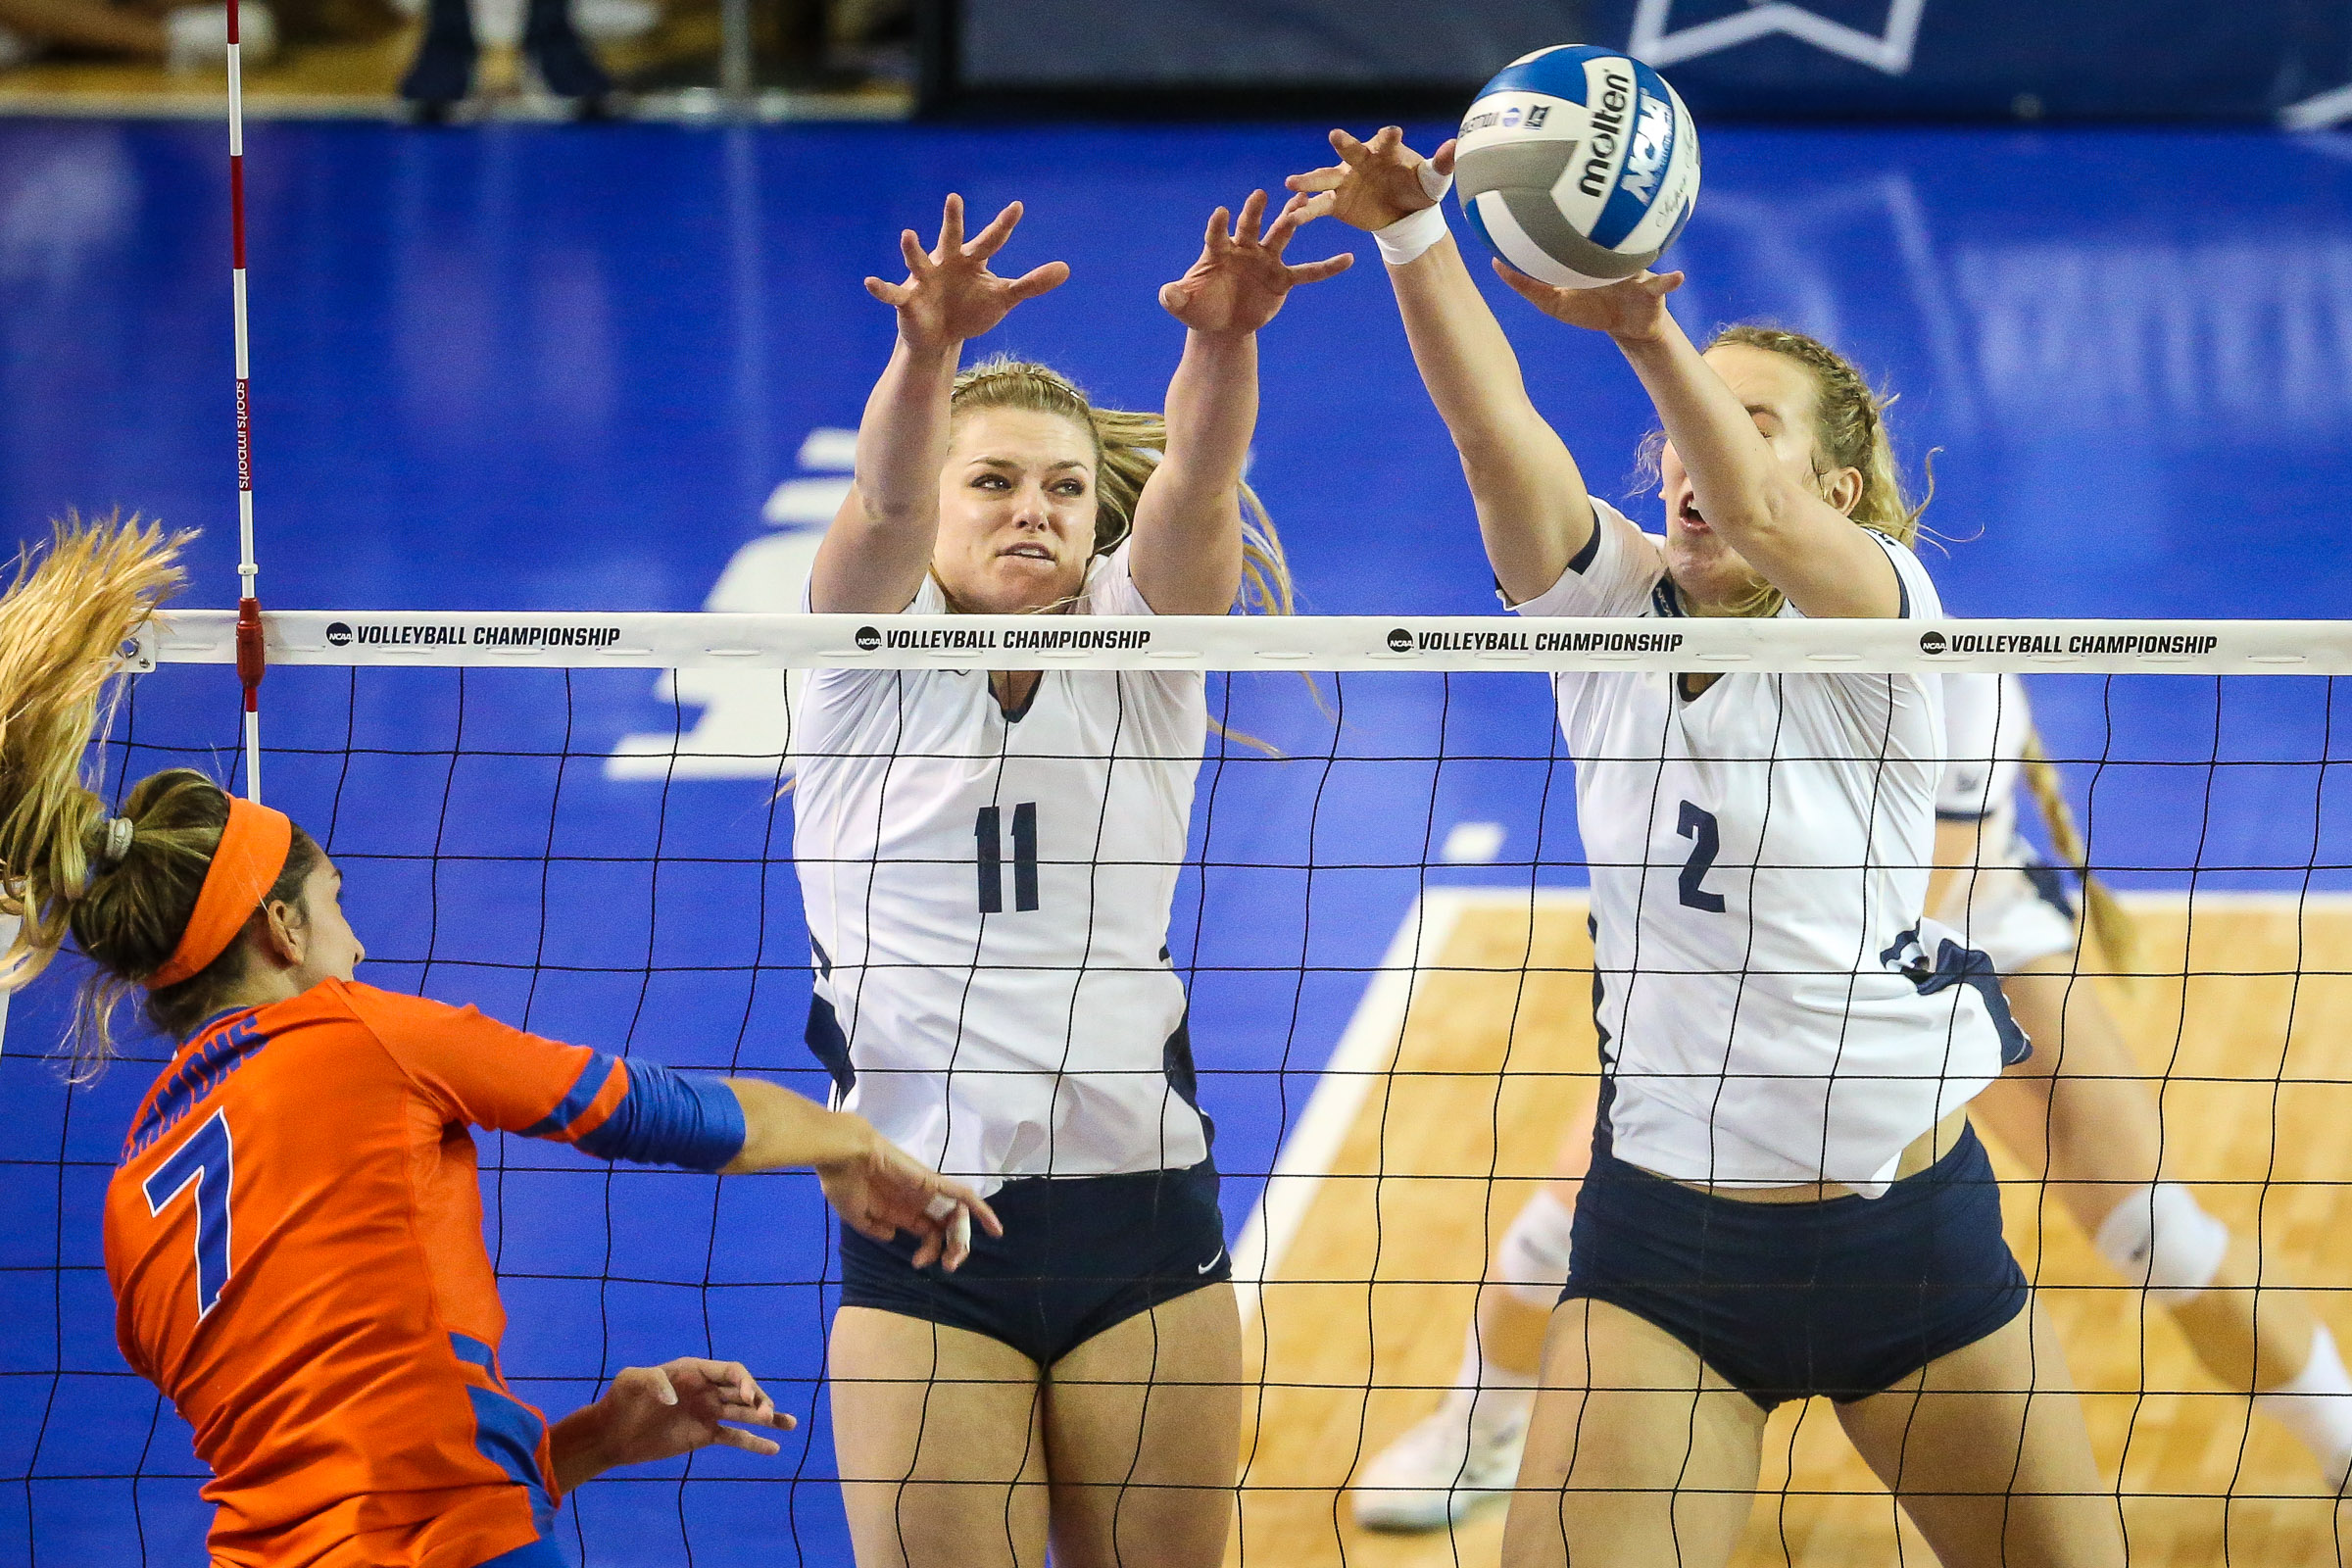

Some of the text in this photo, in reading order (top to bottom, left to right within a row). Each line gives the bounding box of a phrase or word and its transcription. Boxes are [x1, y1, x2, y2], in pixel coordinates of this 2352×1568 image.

[1579, 73, 1630, 198] molten
[1620, 94, 1672, 207] NCAA
[236, 381, 251, 489] sports imports
[328, 625, 621, 647] NCAA VOLLEYBALL CHAMPIONSHIP
[858, 630, 1152, 650] NCAA VOLLEYBALL CHAMPIONSHIP
[1390, 632, 1684, 653] NCAA VOLLEYBALL CHAMPIONSHIP
[1952, 635, 2062, 653] VOLLEYBALL
[2069, 635, 2219, 655] CHAMPIONSHIP
[974, 802, 1039, 913] 11
[1677, 800, 1726, 912] 2
[142, 1105, 232, 1319] 7
